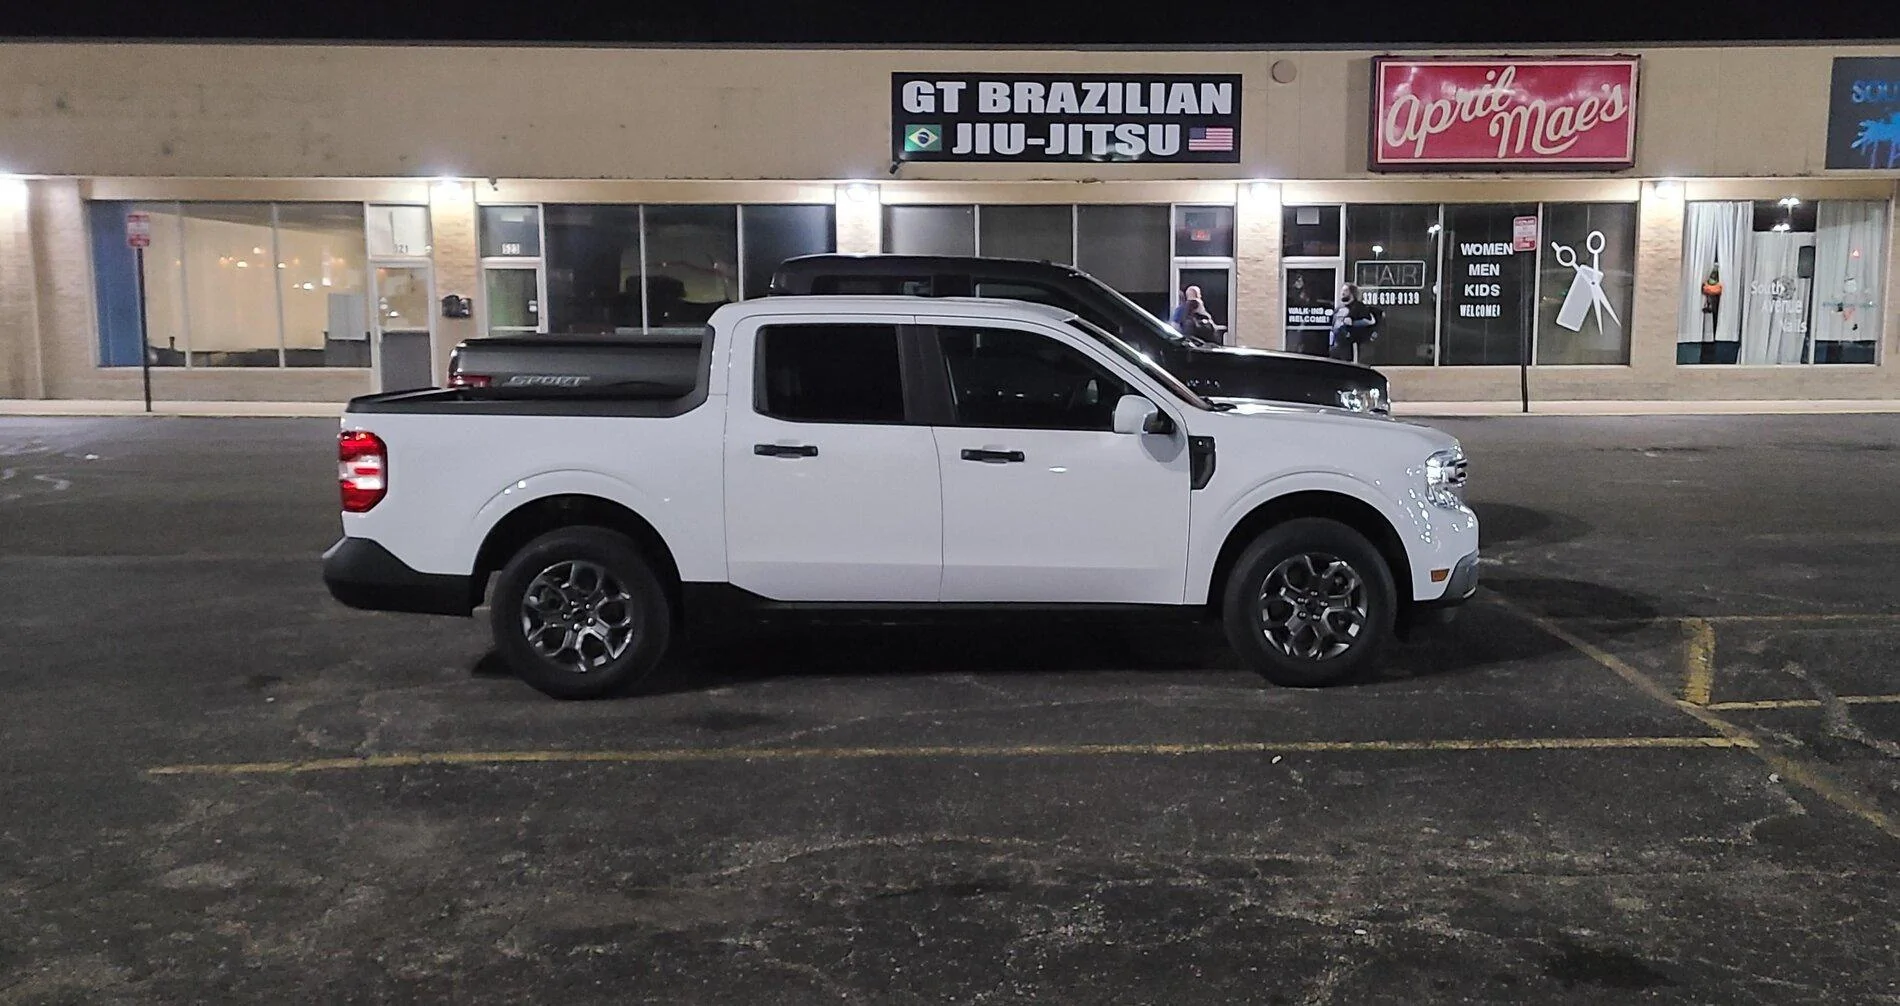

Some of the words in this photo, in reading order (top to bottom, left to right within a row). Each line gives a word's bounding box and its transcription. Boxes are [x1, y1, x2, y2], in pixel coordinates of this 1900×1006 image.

[902, 81, 966, 113] GT
[978, 81, 1232, 114] BRAZILIAN
[1489, 84, 1628, 158] Mae's
[952, 123, 1181, 155] JIU-JITSU
[1460, 243, 1514, 256] WOMEN
[1363, 264, 1417, 285] HAIR
[1469, 263, 1500, 276] MEN
[1464, 284, 1501, 297] KIDS
[1460, 304, 1500, 317] WELCOME!
[502, 375, 591, 388] SPORT
